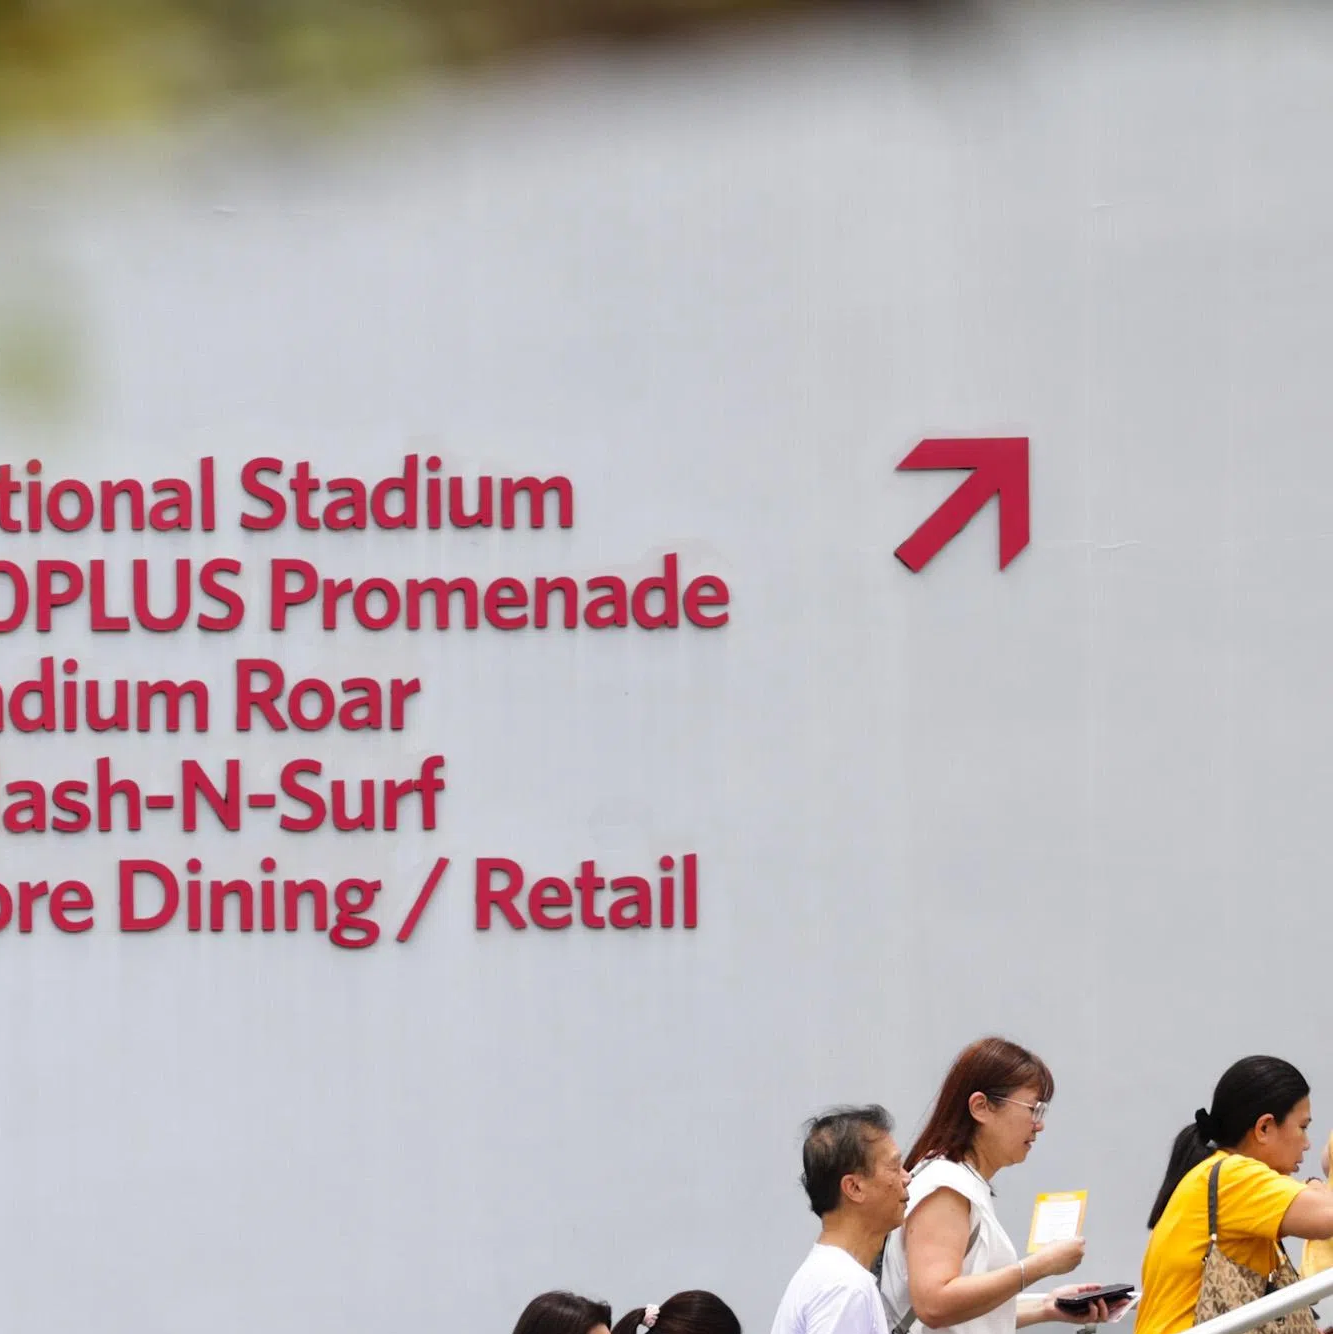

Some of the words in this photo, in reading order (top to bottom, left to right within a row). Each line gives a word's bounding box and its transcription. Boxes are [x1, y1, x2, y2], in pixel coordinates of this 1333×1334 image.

[240, 454, 574, 530] Stadium
[270, 552, 731, 631] Promenade
[236, 659, 422, 731] Roar
[119, 857, 383, 949] Dining
[397, 857, 450, 941] /
[475, 853, 698, 929] Retail
